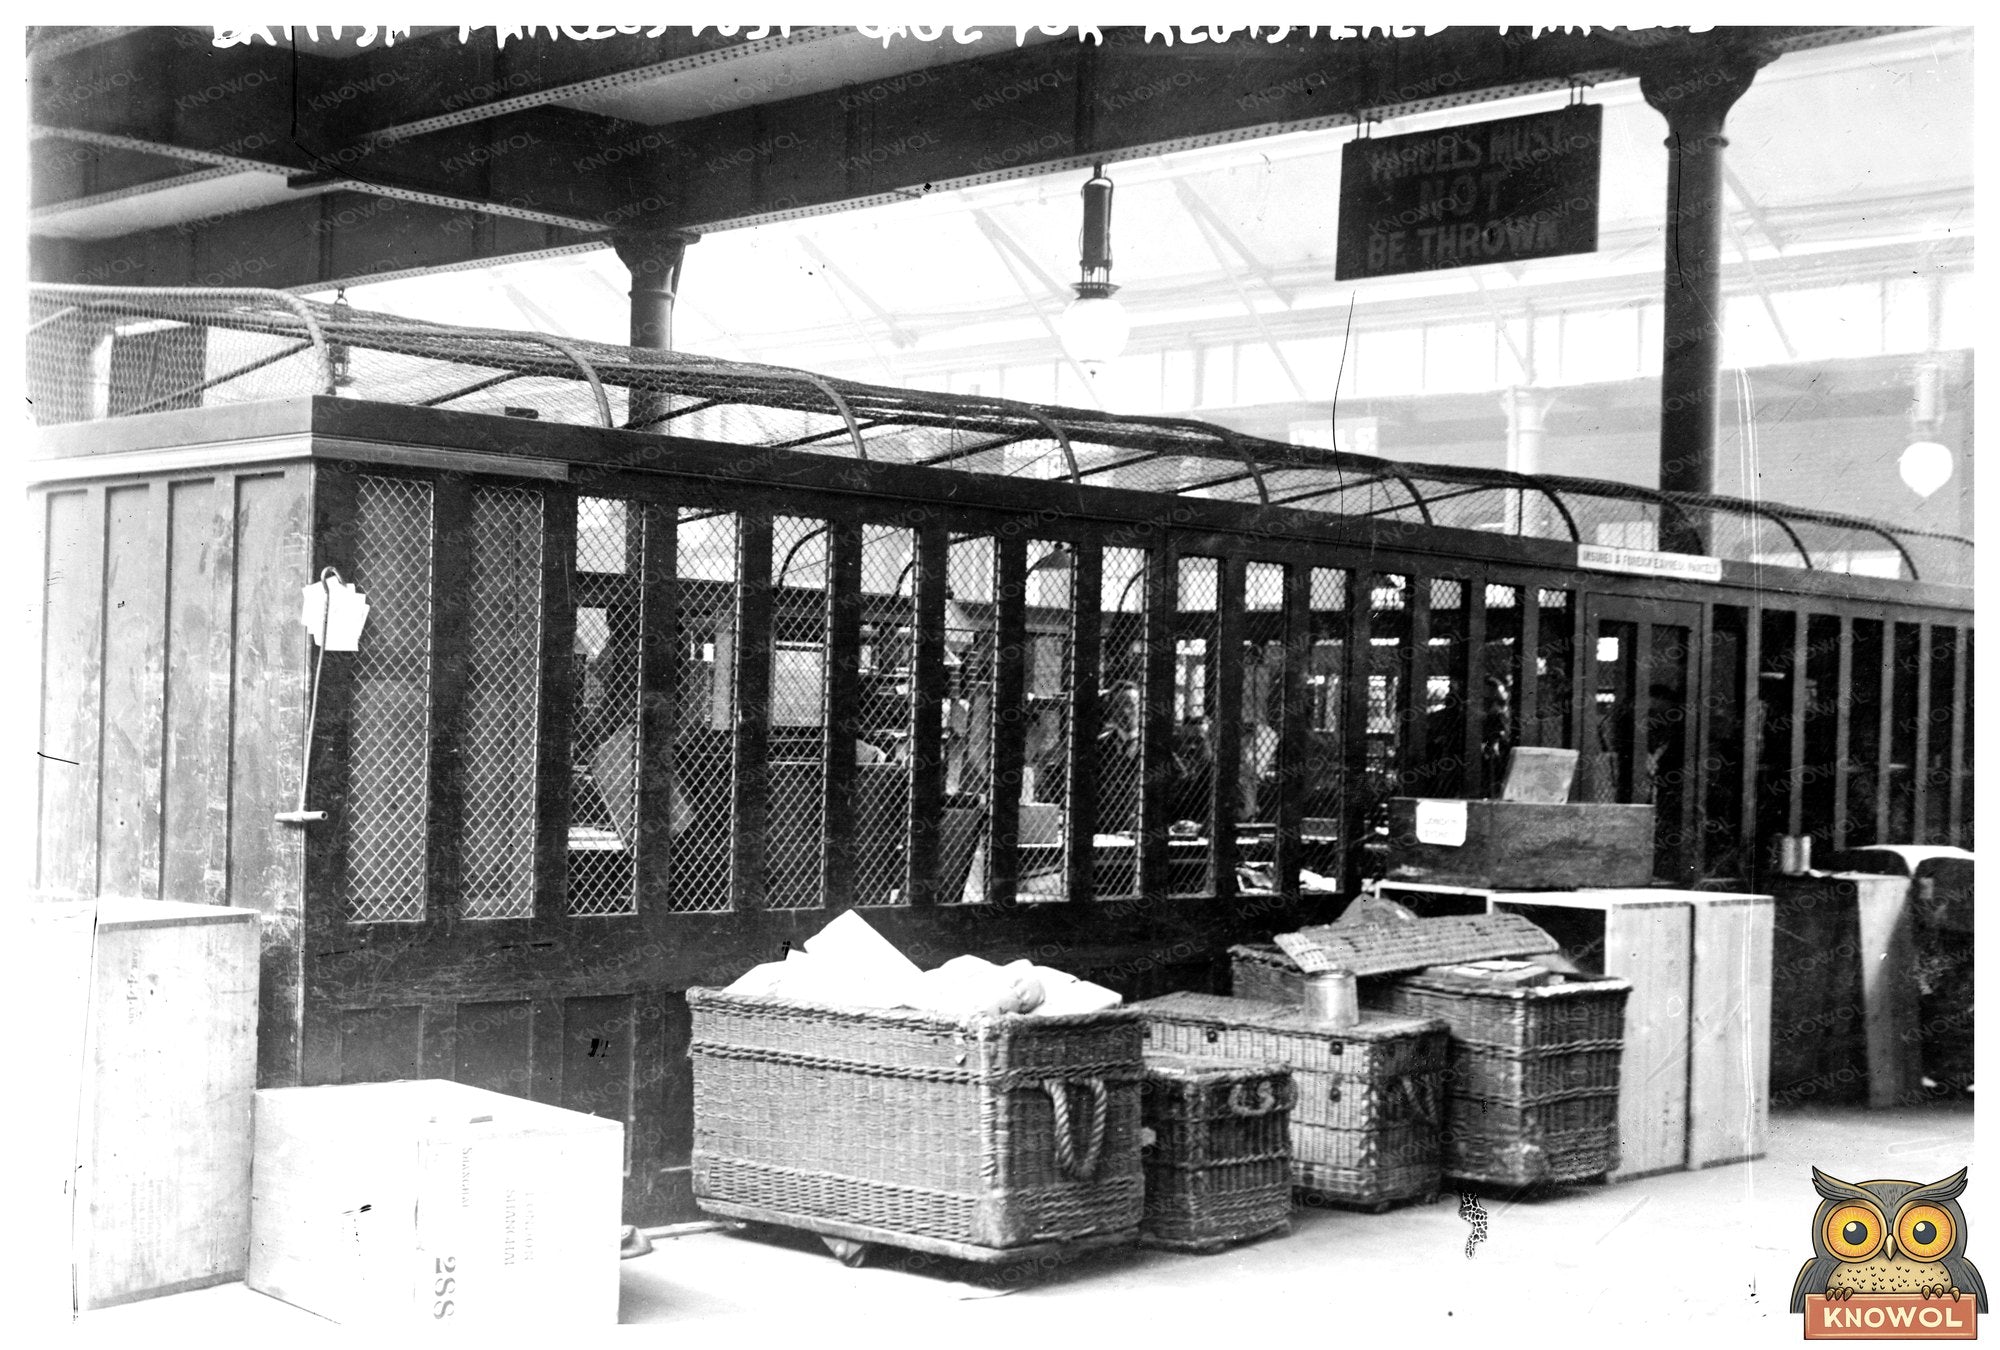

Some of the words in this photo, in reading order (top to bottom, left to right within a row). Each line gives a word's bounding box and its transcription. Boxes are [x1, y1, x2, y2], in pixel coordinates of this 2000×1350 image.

[1419, 171, 1508, 216] NOT
[1367, 230, 1407, 270] BE
[1417, 219, 1560, 262] THROWN
[503, 1189, 517, 1267] SHANGHAI
